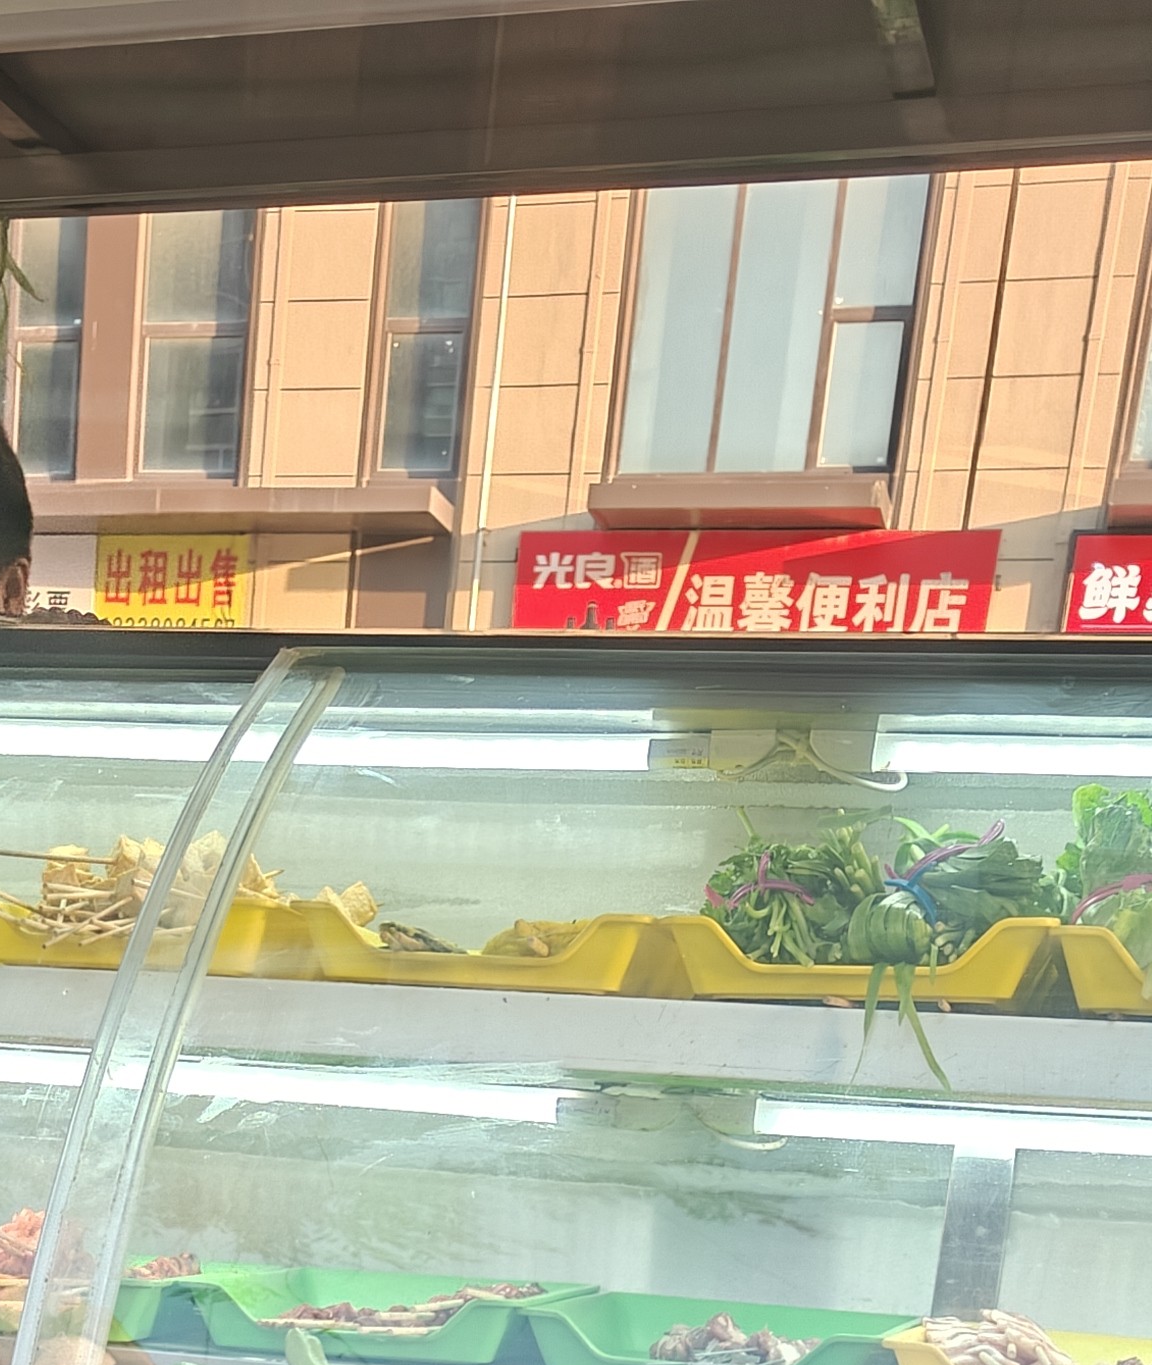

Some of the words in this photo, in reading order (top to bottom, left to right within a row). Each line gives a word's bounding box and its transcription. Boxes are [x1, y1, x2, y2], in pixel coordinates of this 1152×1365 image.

[103, 548, 239, 608] 出租出售
[681, 571, 969, 632] 温馨便利店
[1078, 562, 1152, 623] 鲜
